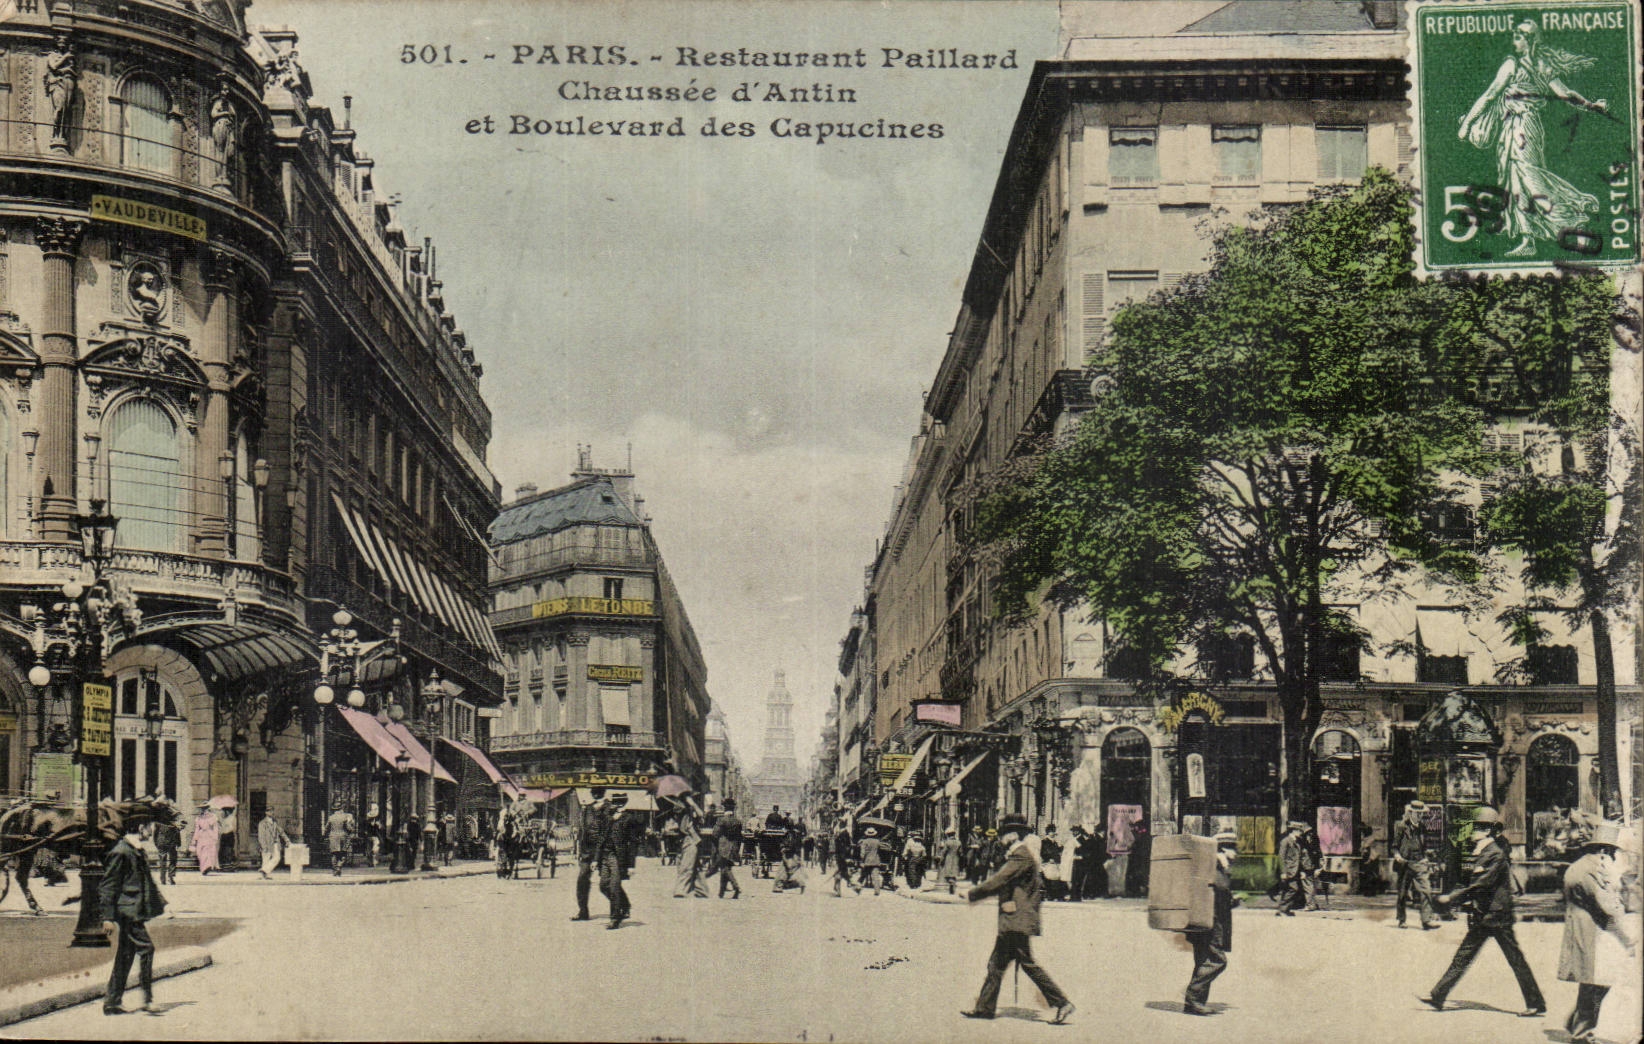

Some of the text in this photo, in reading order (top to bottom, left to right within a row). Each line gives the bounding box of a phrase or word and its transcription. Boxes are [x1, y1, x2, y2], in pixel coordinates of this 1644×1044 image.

[1542, 11, 1625, 35] FRANÇAISE
[102, 199, 200, 234] VAUDEVILLE
[1609, 163, 1631, 250] POSTES
[85, 686, 109, 697] OLYMPIA
[605, 775, 649, 785] VELO
